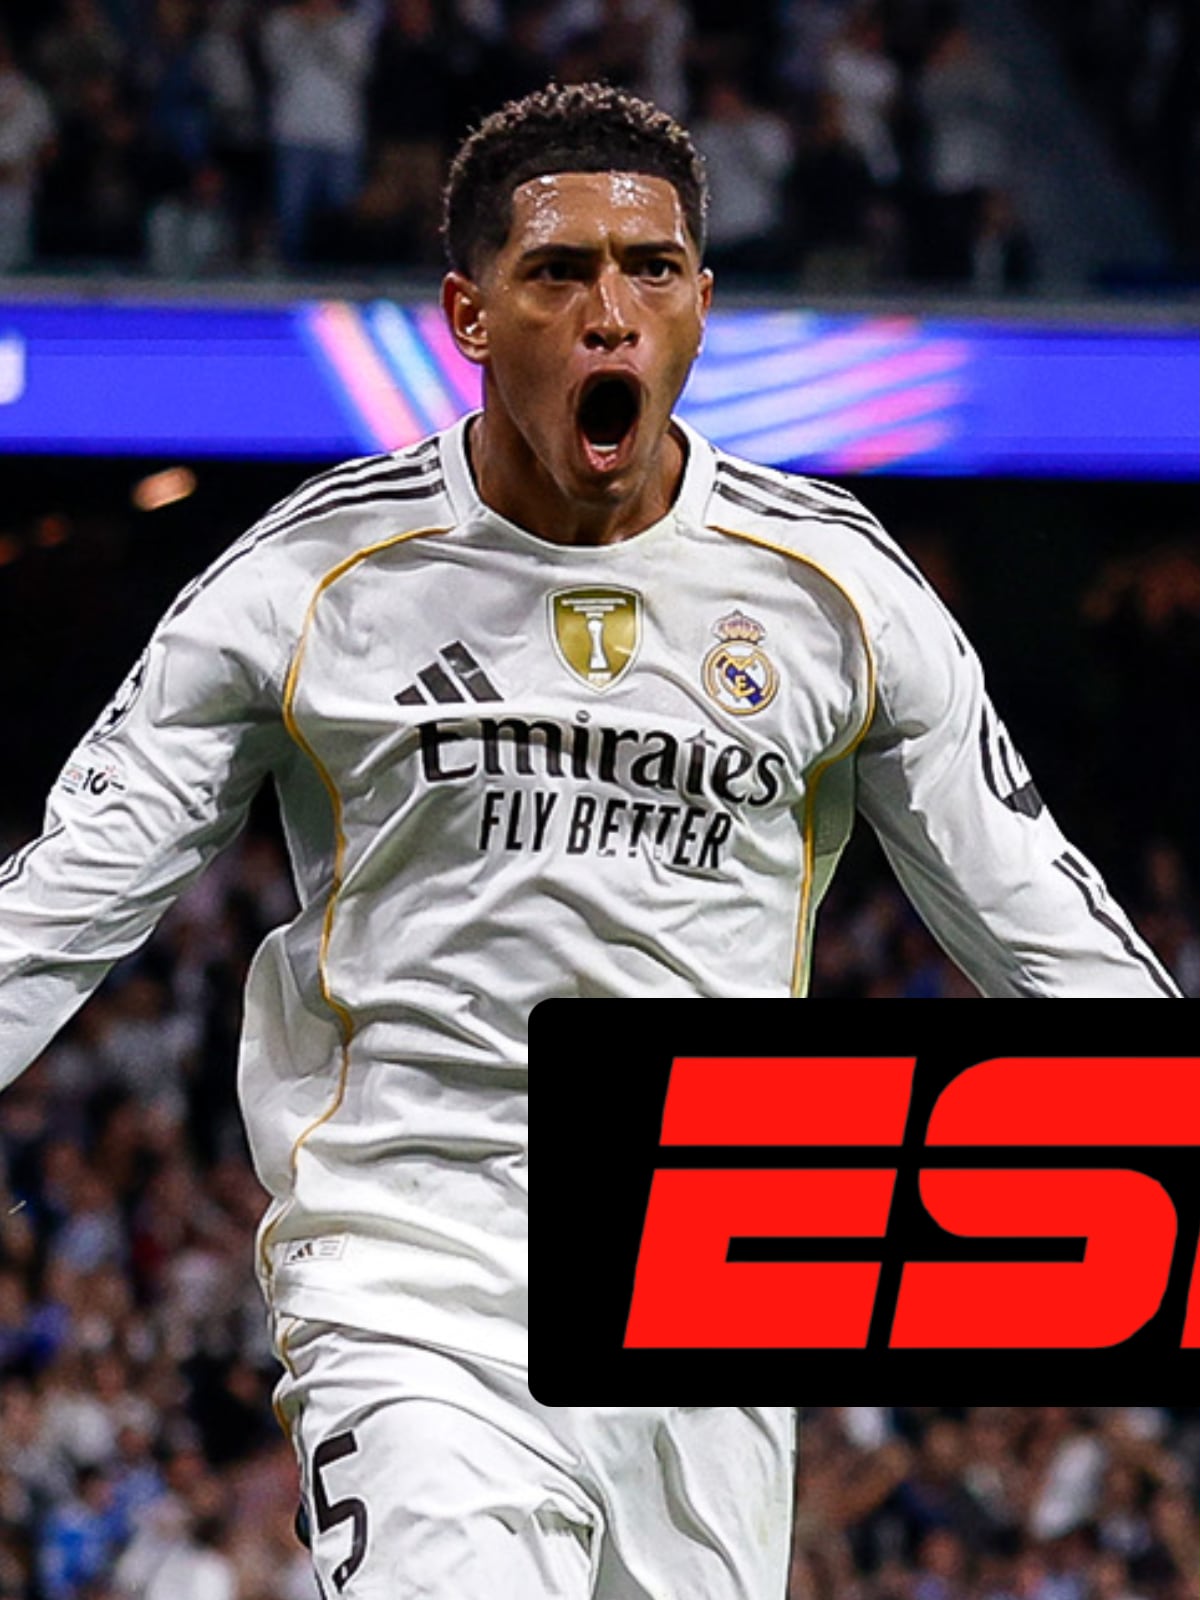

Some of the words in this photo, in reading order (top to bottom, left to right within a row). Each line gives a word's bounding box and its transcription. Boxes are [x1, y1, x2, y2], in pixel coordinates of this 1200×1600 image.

[416, 708, 786, 807] Emirates
[478, 790, 558, 852] FLY
[566, 796, 734, 870] BETTER
[313, 1429, 368, 1595] 5
